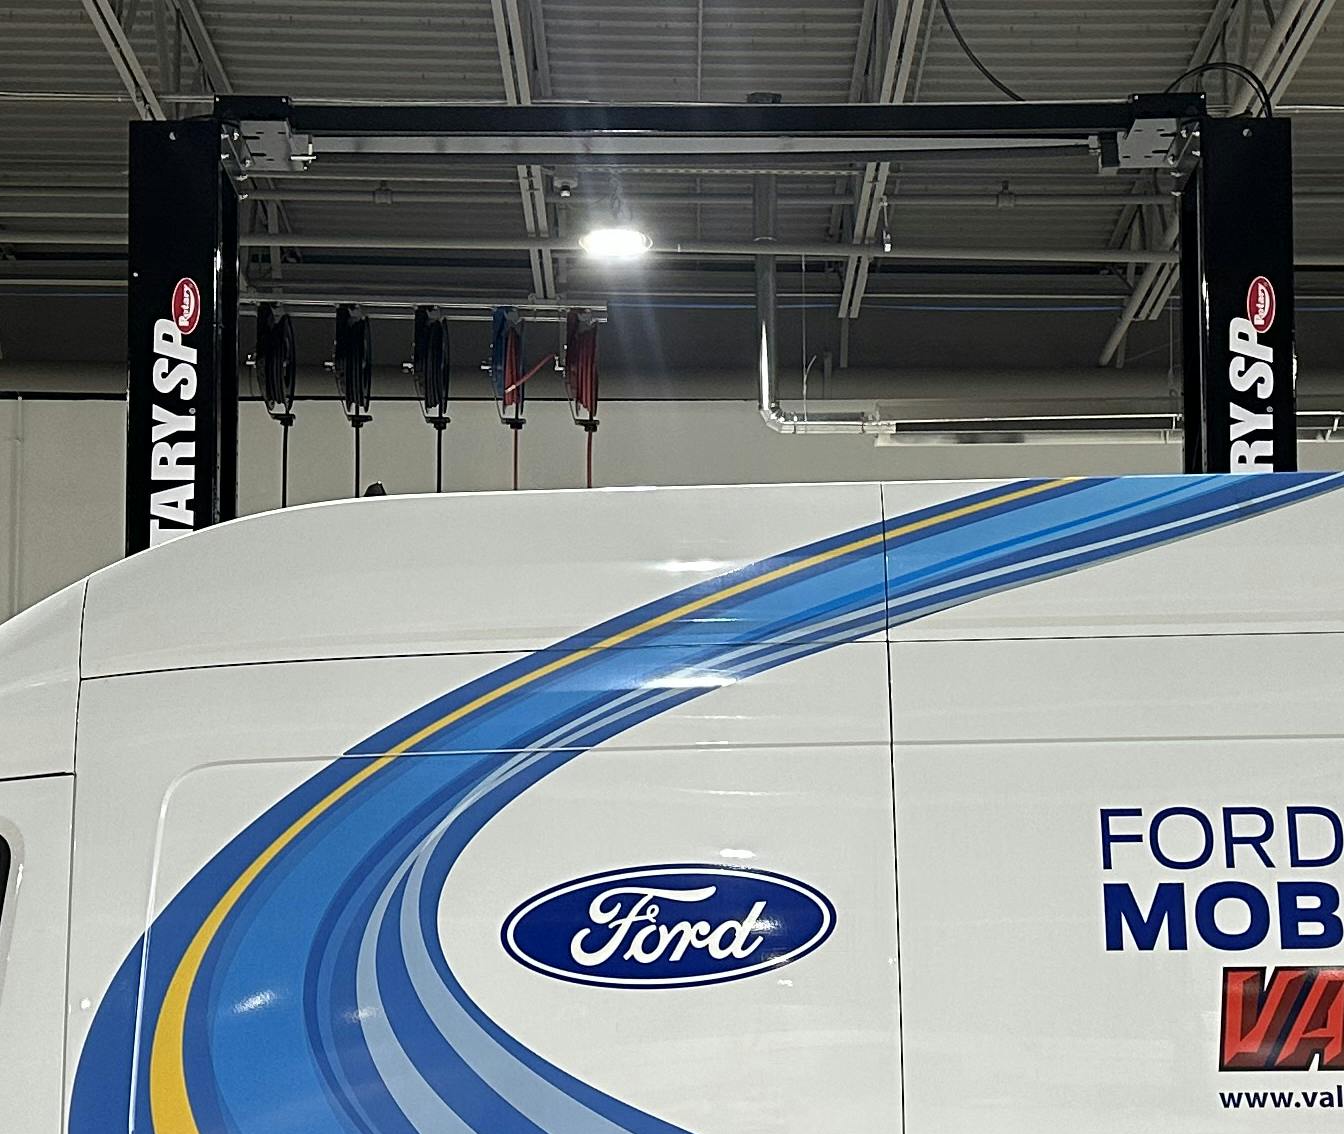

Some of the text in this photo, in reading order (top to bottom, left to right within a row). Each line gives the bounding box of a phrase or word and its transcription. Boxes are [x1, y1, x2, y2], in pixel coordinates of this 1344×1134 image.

[179, 283, 196, 327] Rotary
[1253, 282, 1270, 326] Rotary
[152, 318, 197, 401] SP
[1228, 317, 1274, 400] SP
[1099, 805, 1344, 870] FORD
[570, 886, 767, 967] Ford
